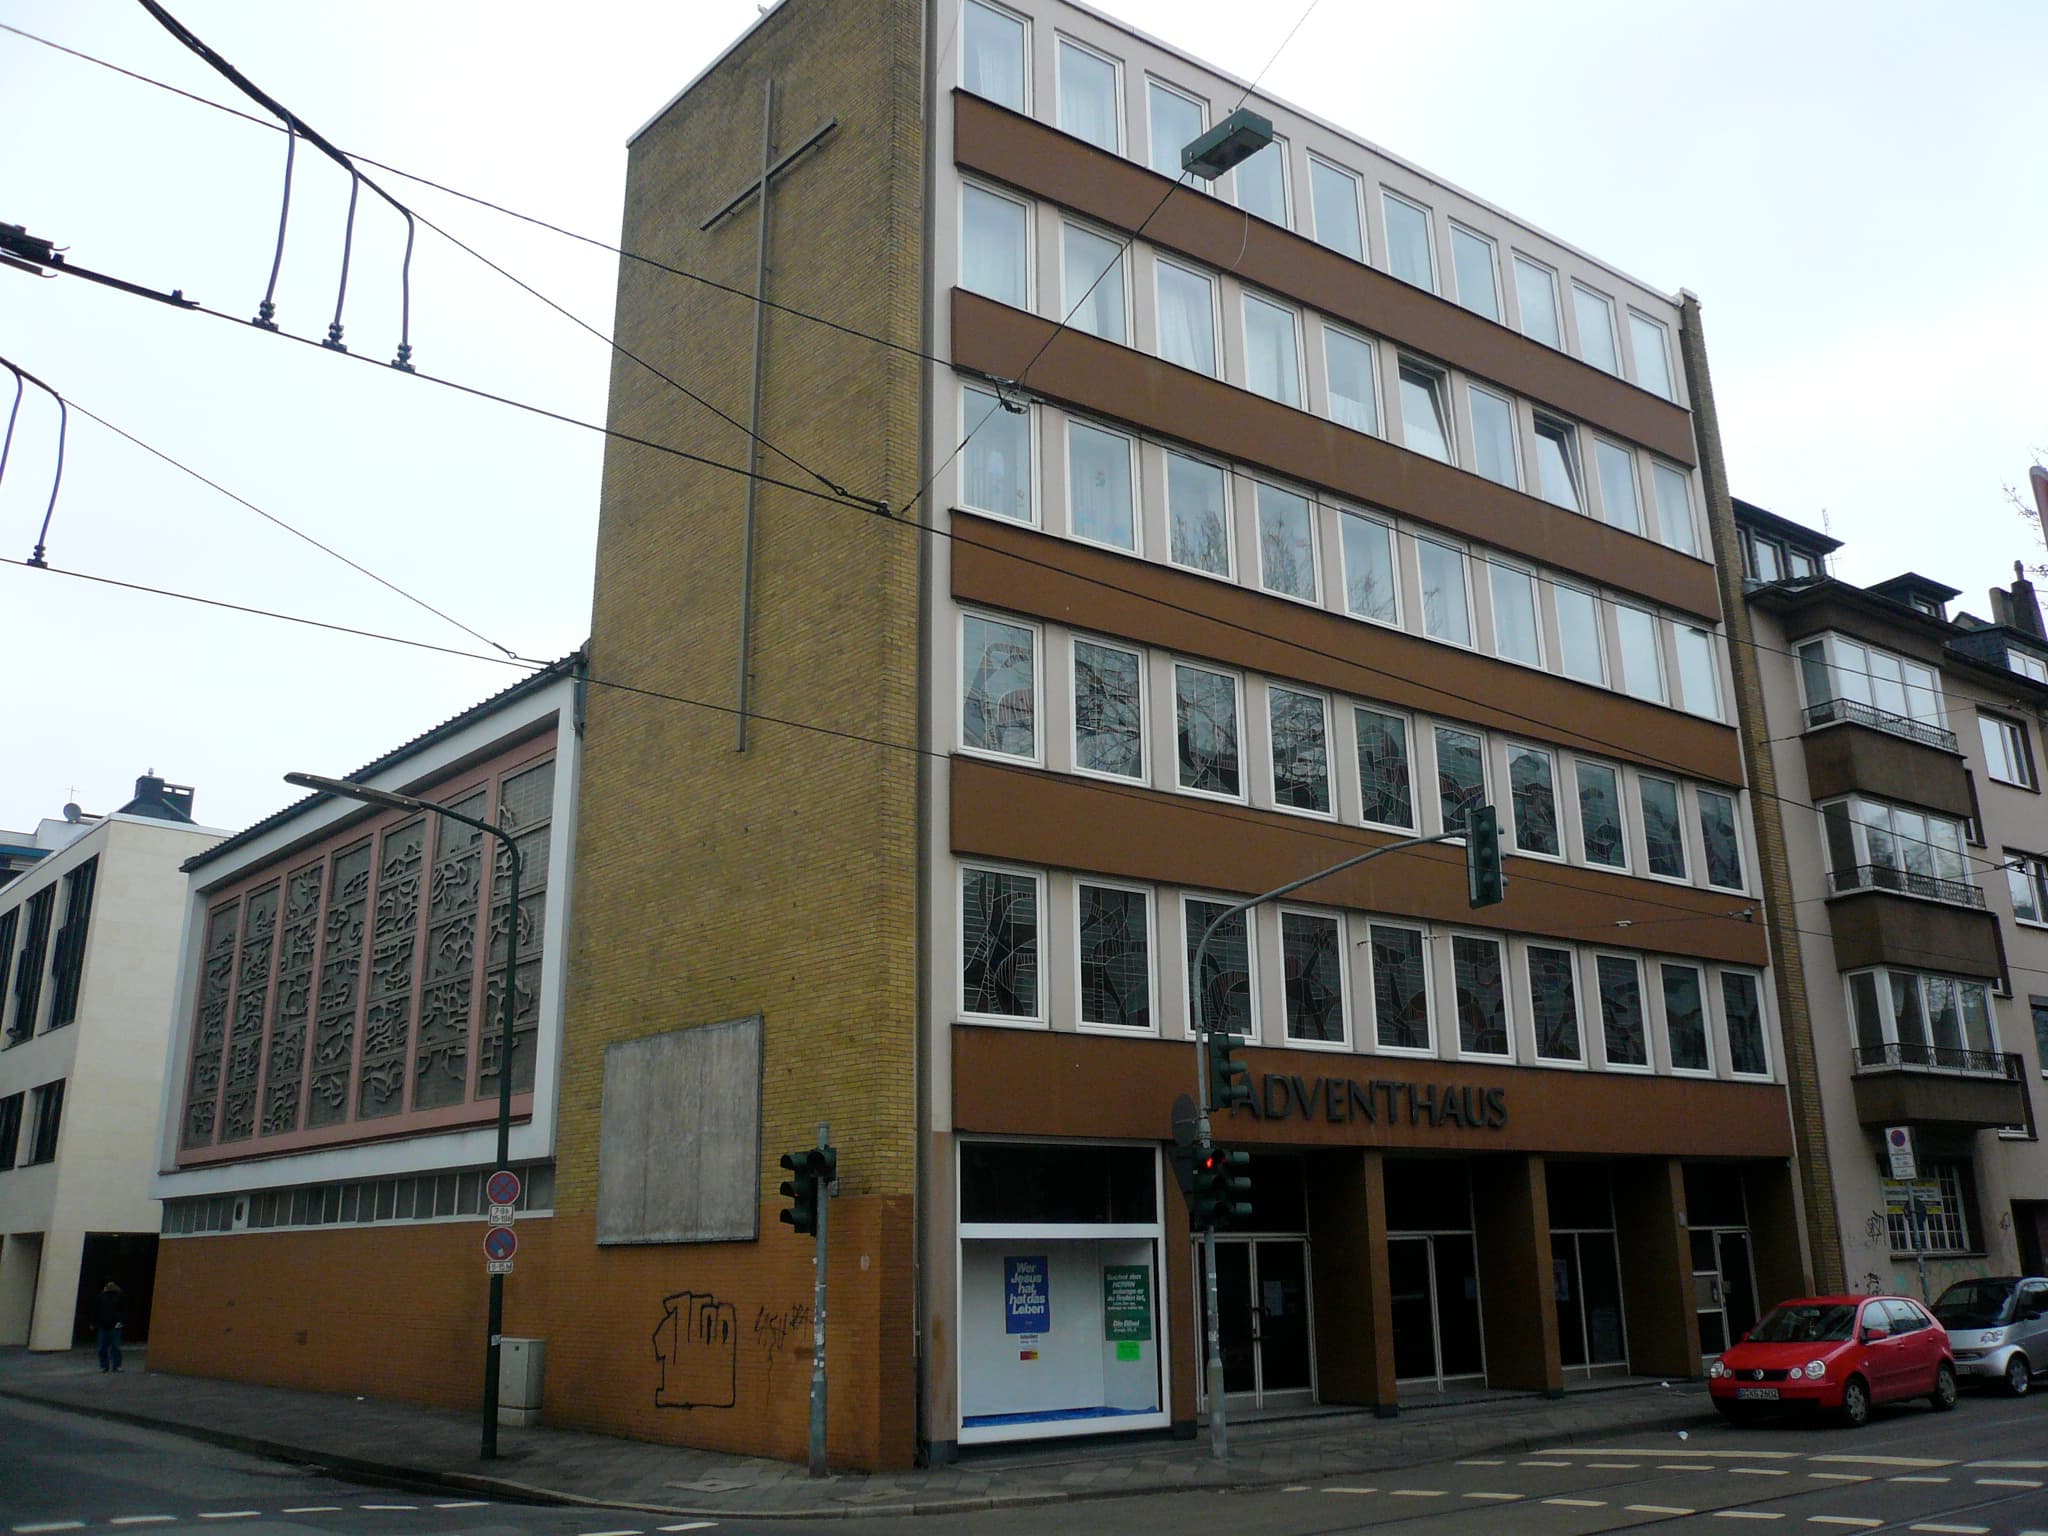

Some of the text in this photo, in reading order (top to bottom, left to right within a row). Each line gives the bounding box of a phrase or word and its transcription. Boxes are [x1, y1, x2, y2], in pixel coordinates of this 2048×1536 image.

[1231, 1073, 1508, 1128] ADVENTHAUS
[1016, 1262, 1037, 1273] Wer
[1010, 1273, 1042, 1283] Jesus
[1018, 1284, 1037, 1295] hat,
[1012, 1303, 1044, 1315] Leben
